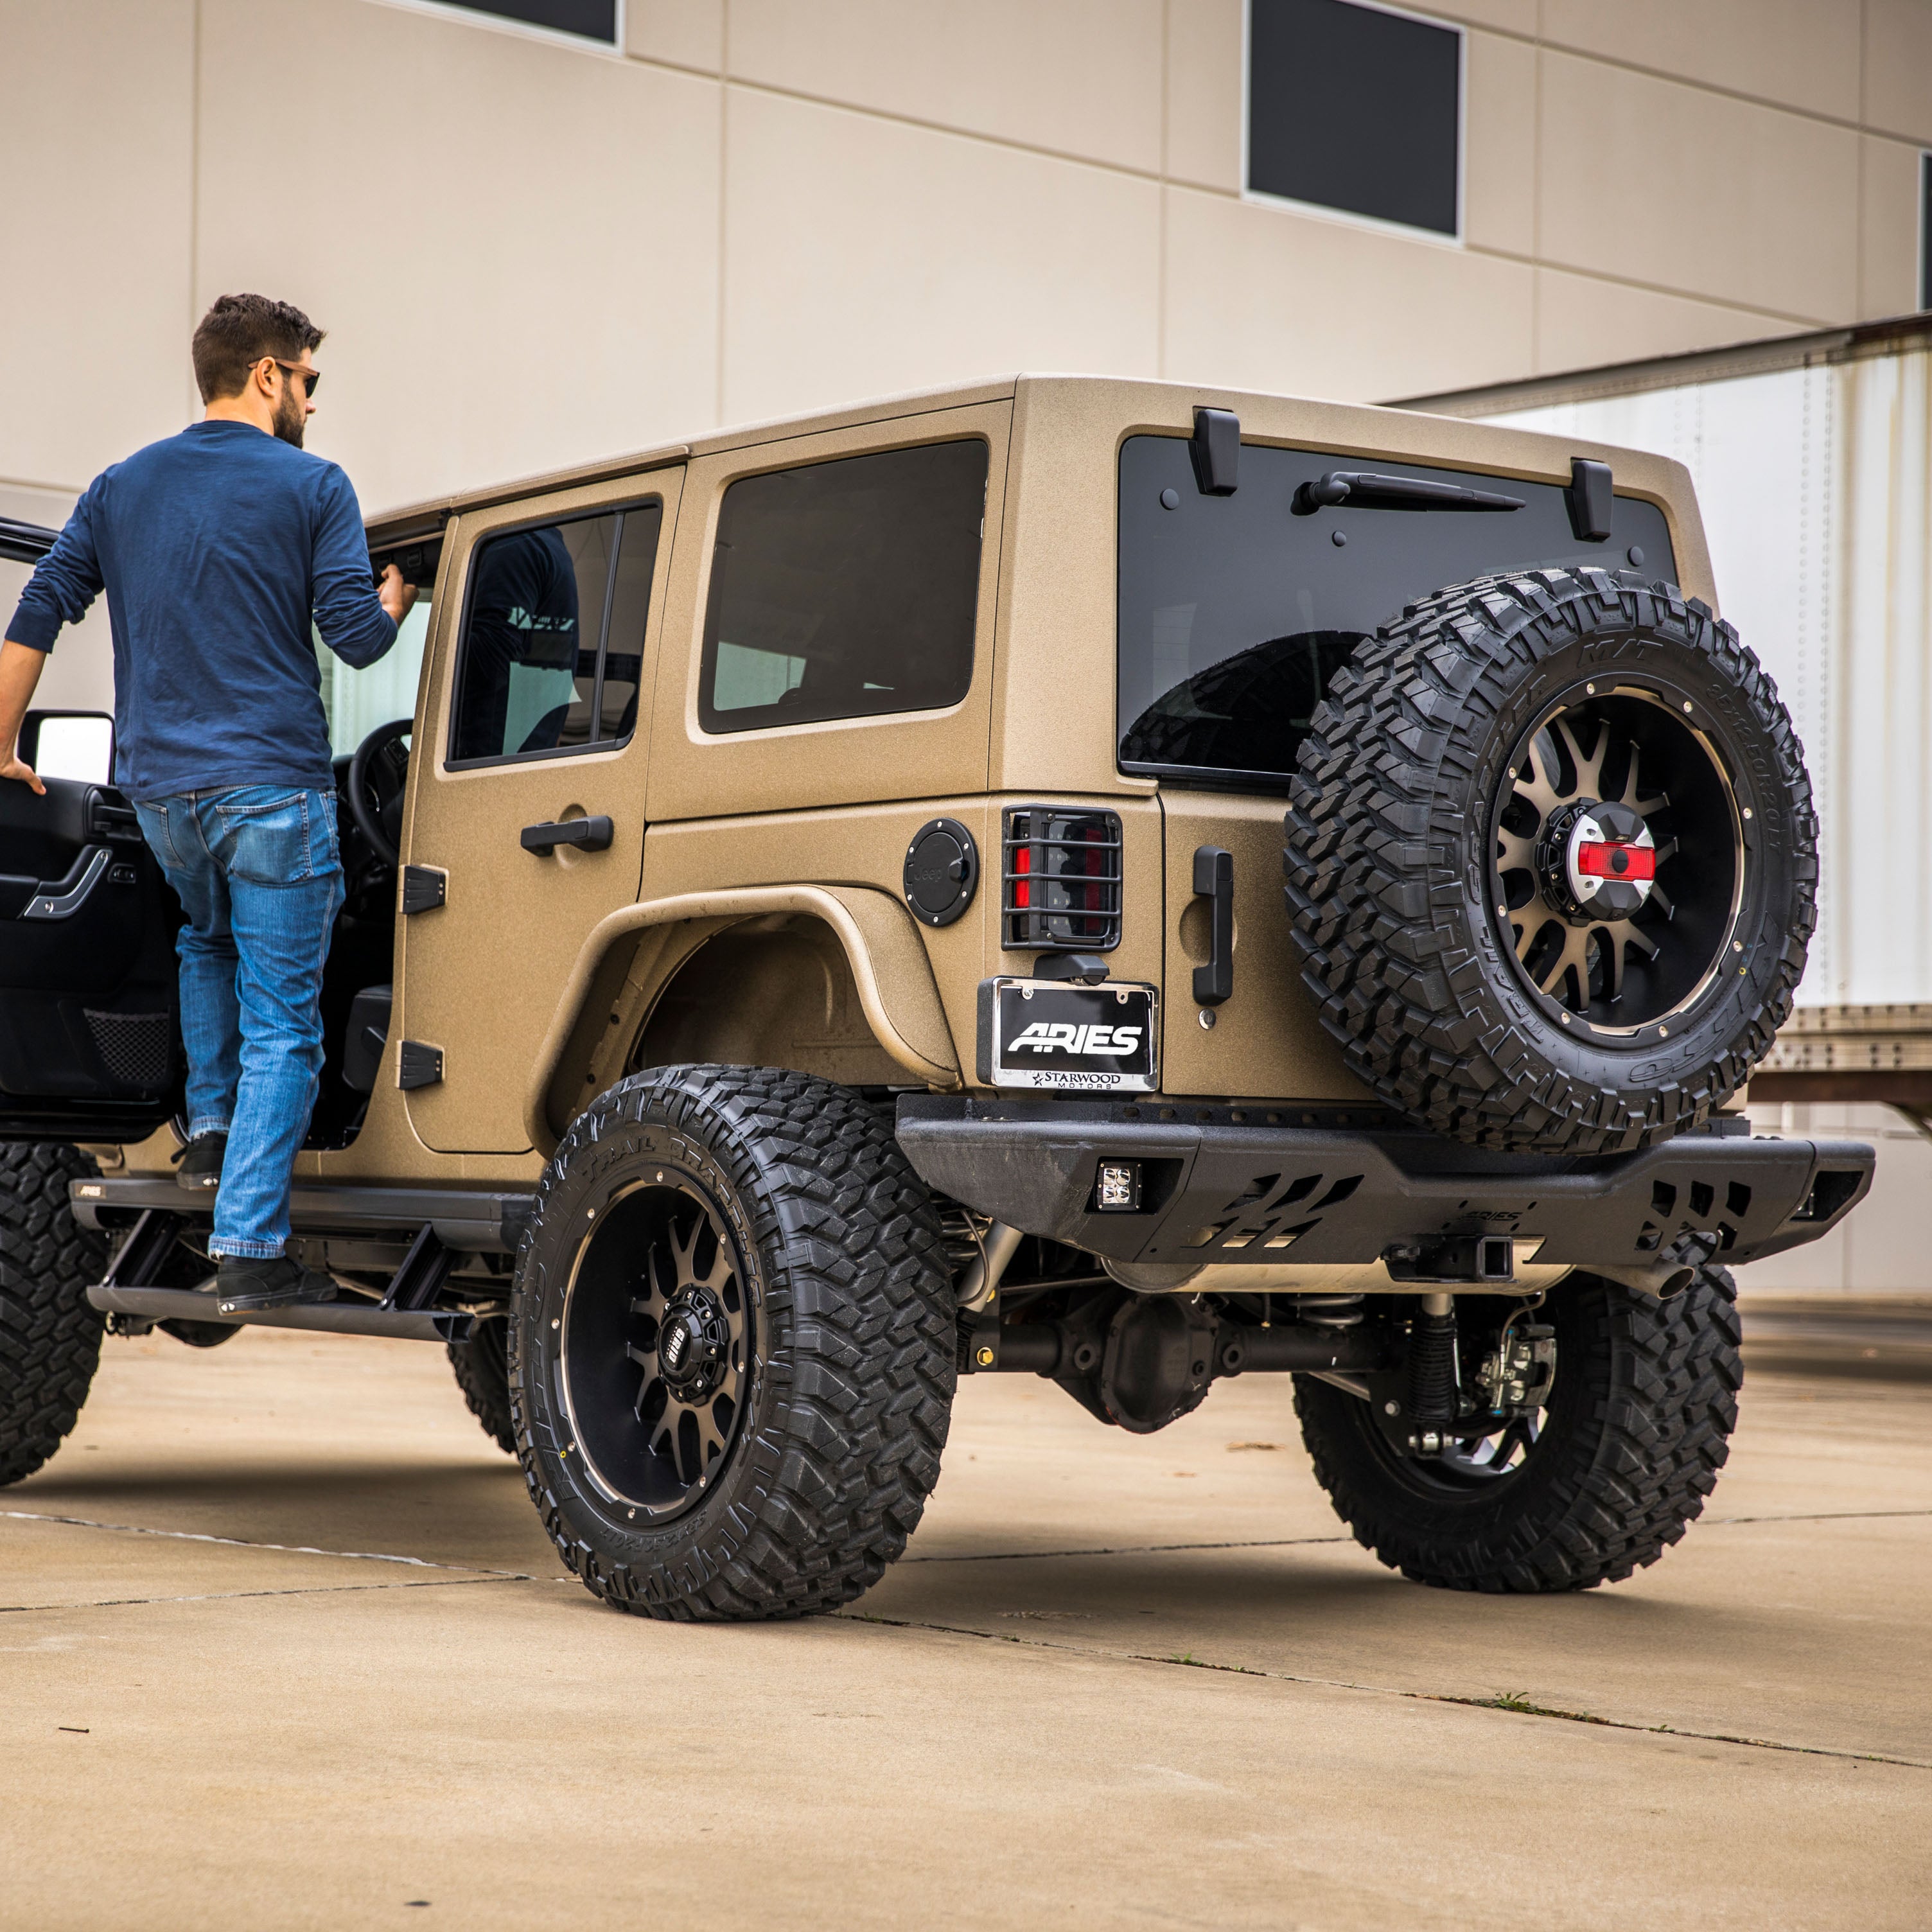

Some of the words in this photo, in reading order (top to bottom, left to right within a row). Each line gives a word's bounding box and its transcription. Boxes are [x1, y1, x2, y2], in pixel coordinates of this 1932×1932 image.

[1577, 640, 1663, 667] M/T
[913, 864, 943, 883] Jeep
[1008, 1023, 1143, 1055] ARIES
[1045, 1071, 1120, 1084] STARWOOD
[581, 1135, 656, 1183] TRAIL
[669, 1327, 685, 1364] GRID
